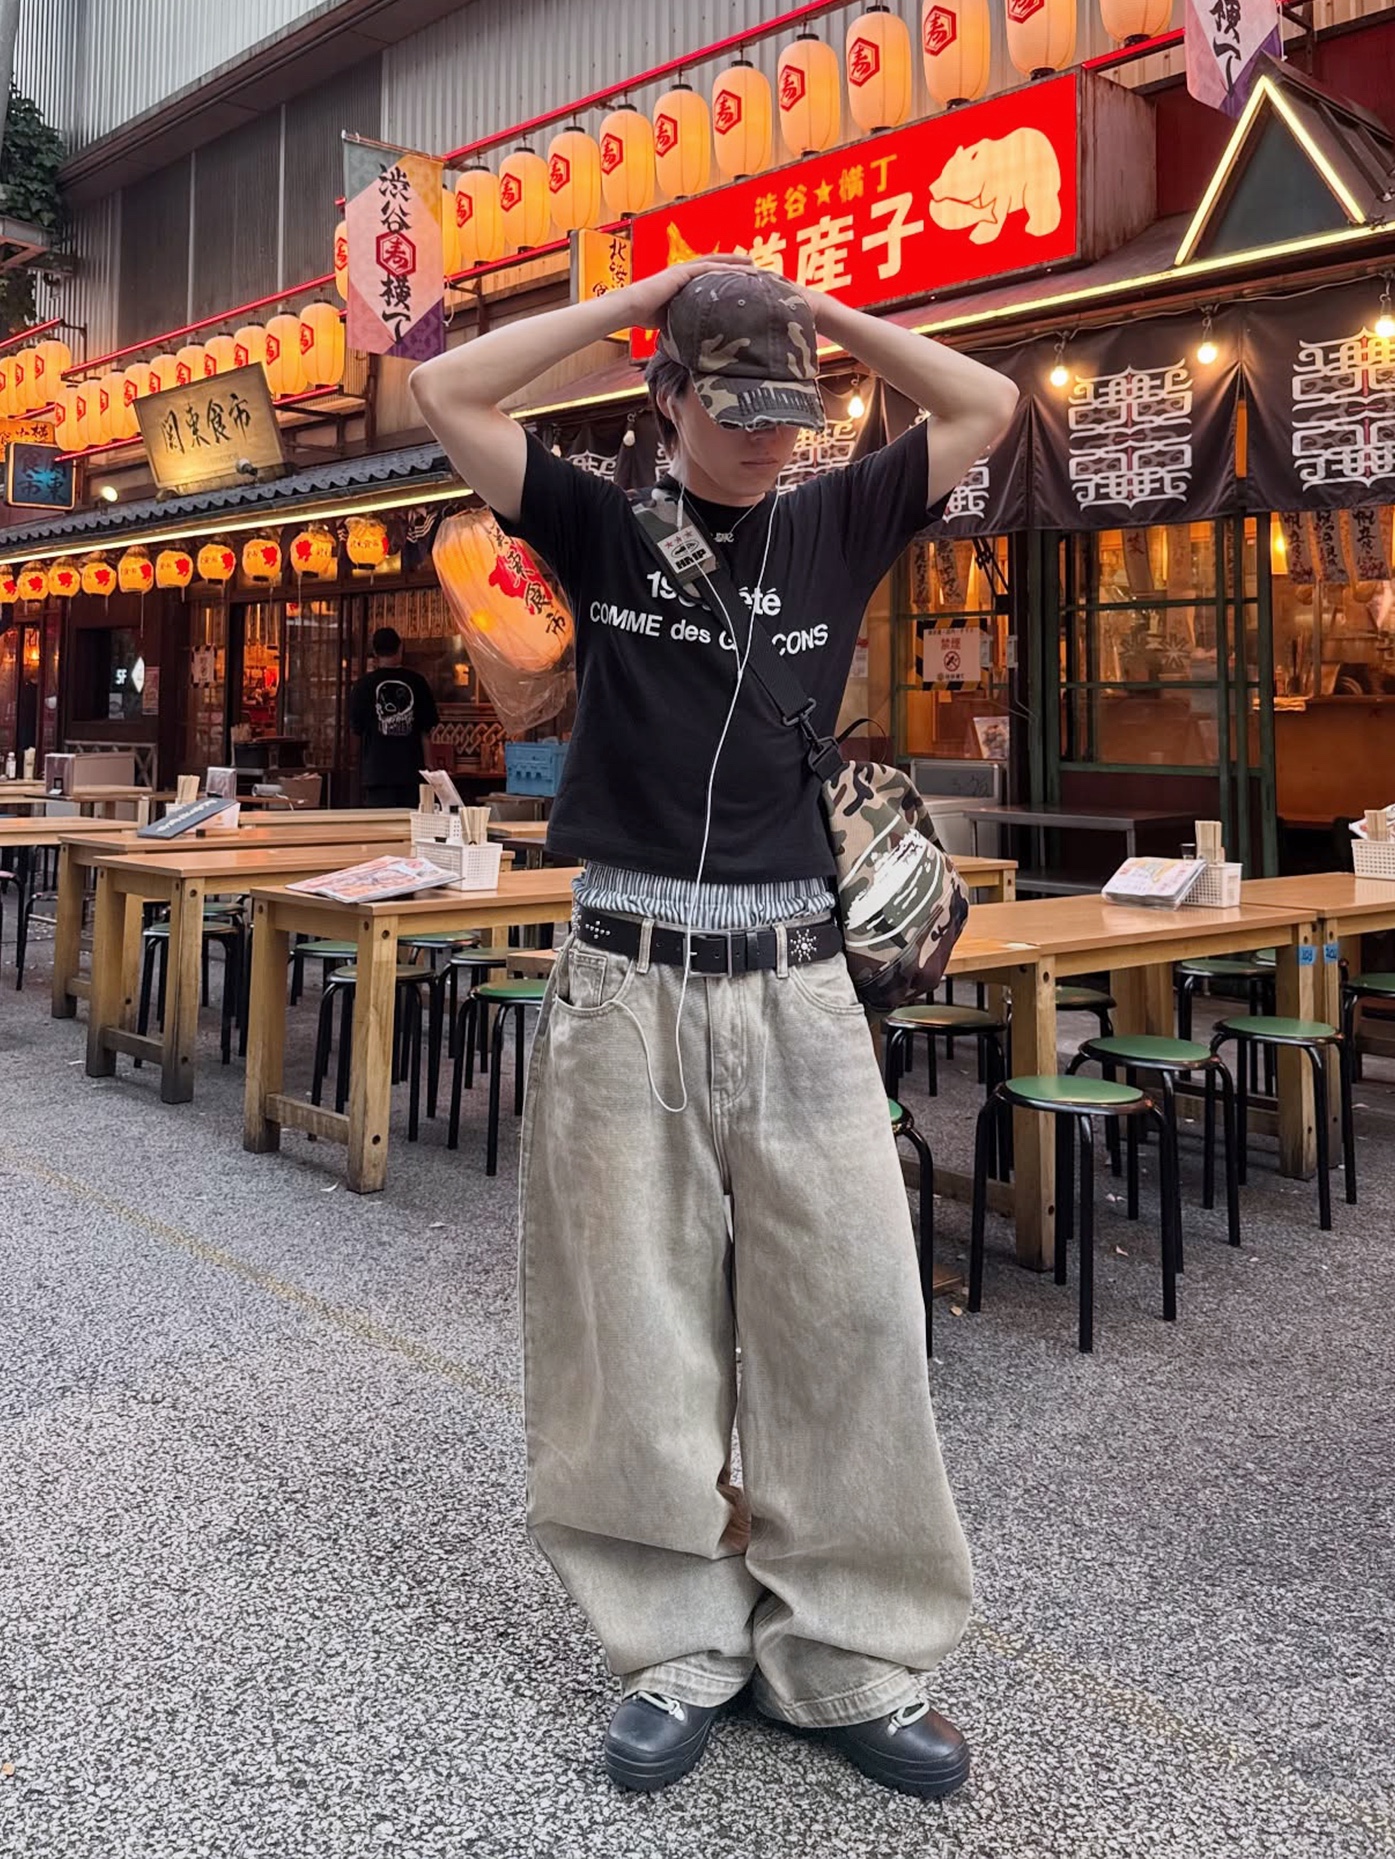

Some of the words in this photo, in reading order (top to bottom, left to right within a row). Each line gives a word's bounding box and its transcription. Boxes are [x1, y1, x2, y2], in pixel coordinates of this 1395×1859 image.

[926, 13, 949, 51] 寿
[851, 45, 873, 81] 寿
[780, 72, 799, 106] 寿
[715, 98, 734, 129] 寿
[656, 120, 672, 151] 寿
[601, 139, 617, 170] 寿
[550, 157, 565, 188] 寿
[501, 178, 515, 208] 寿
[589, 600, 663, 637] COMME
[670, 619, 711, 644] des
